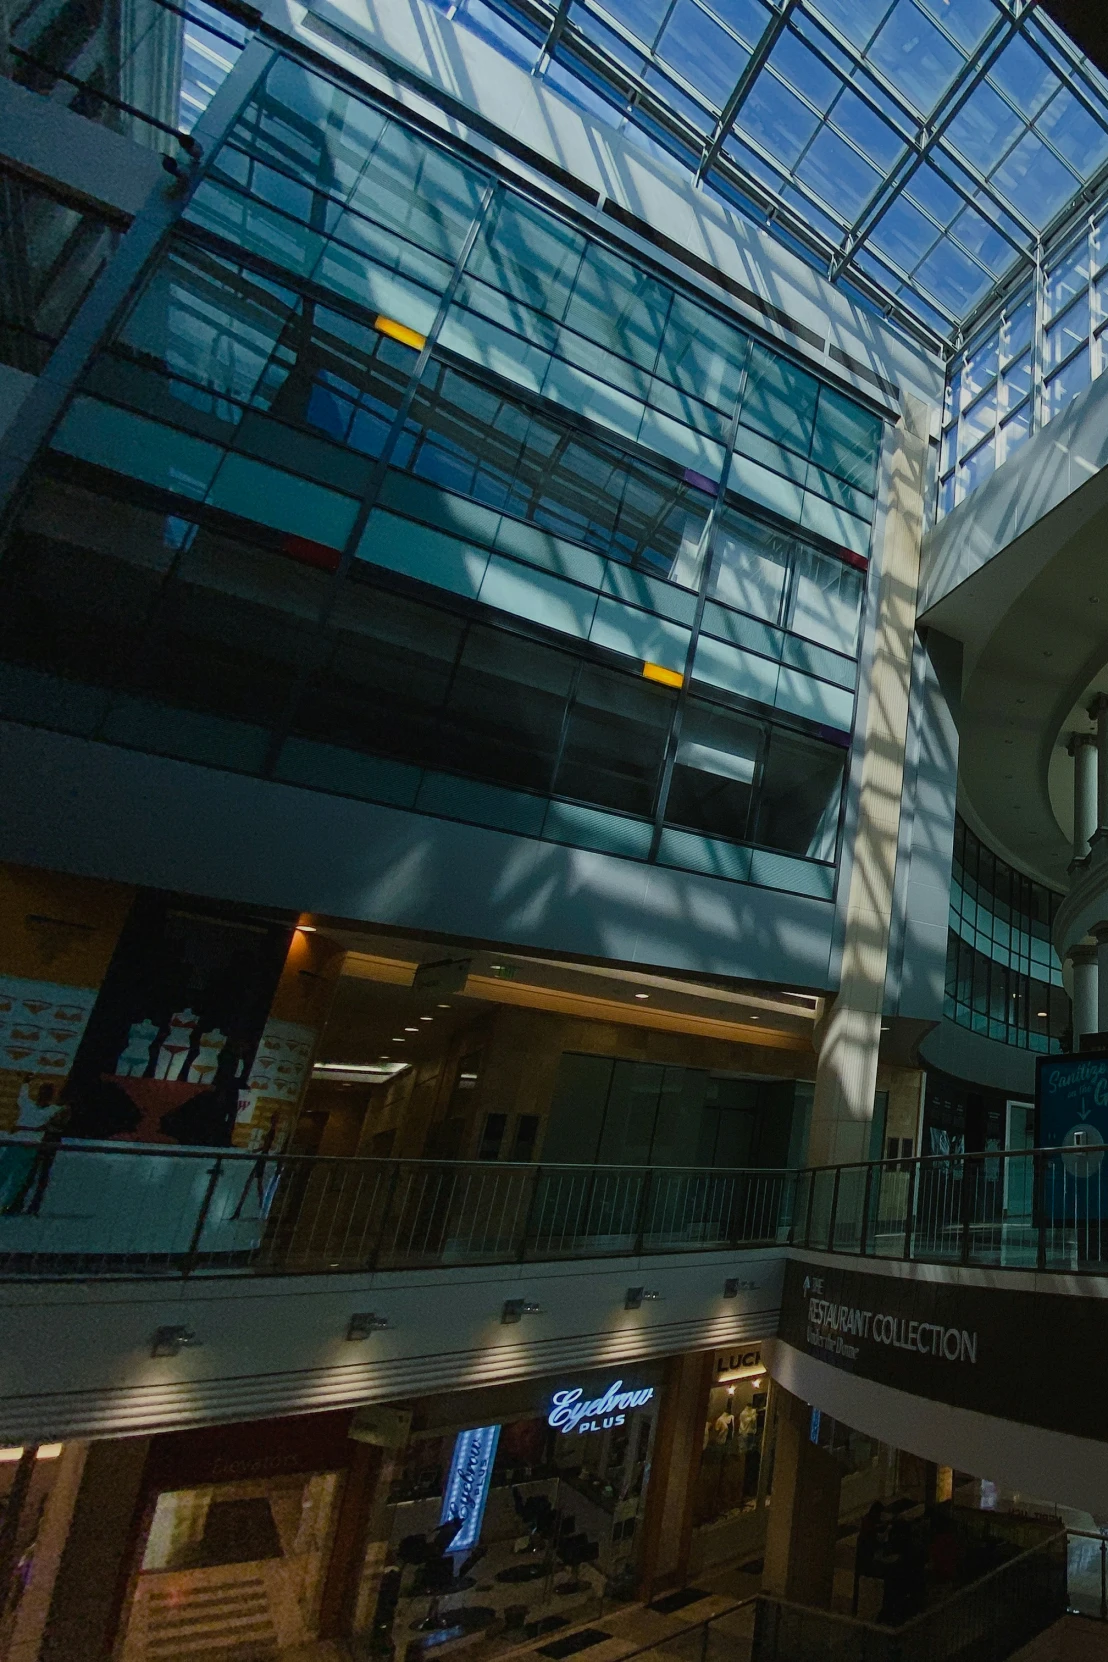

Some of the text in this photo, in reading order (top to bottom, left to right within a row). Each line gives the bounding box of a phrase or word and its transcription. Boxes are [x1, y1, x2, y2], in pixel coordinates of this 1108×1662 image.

[1048, 1060, 1107, 1094] Sanitize
[808, 1298, 978, 1363] RESTAURANT COLLECTION
[548, 1380, 654, 1434] Eyebrow
[579, 1414, 626, 1434] PLUS
